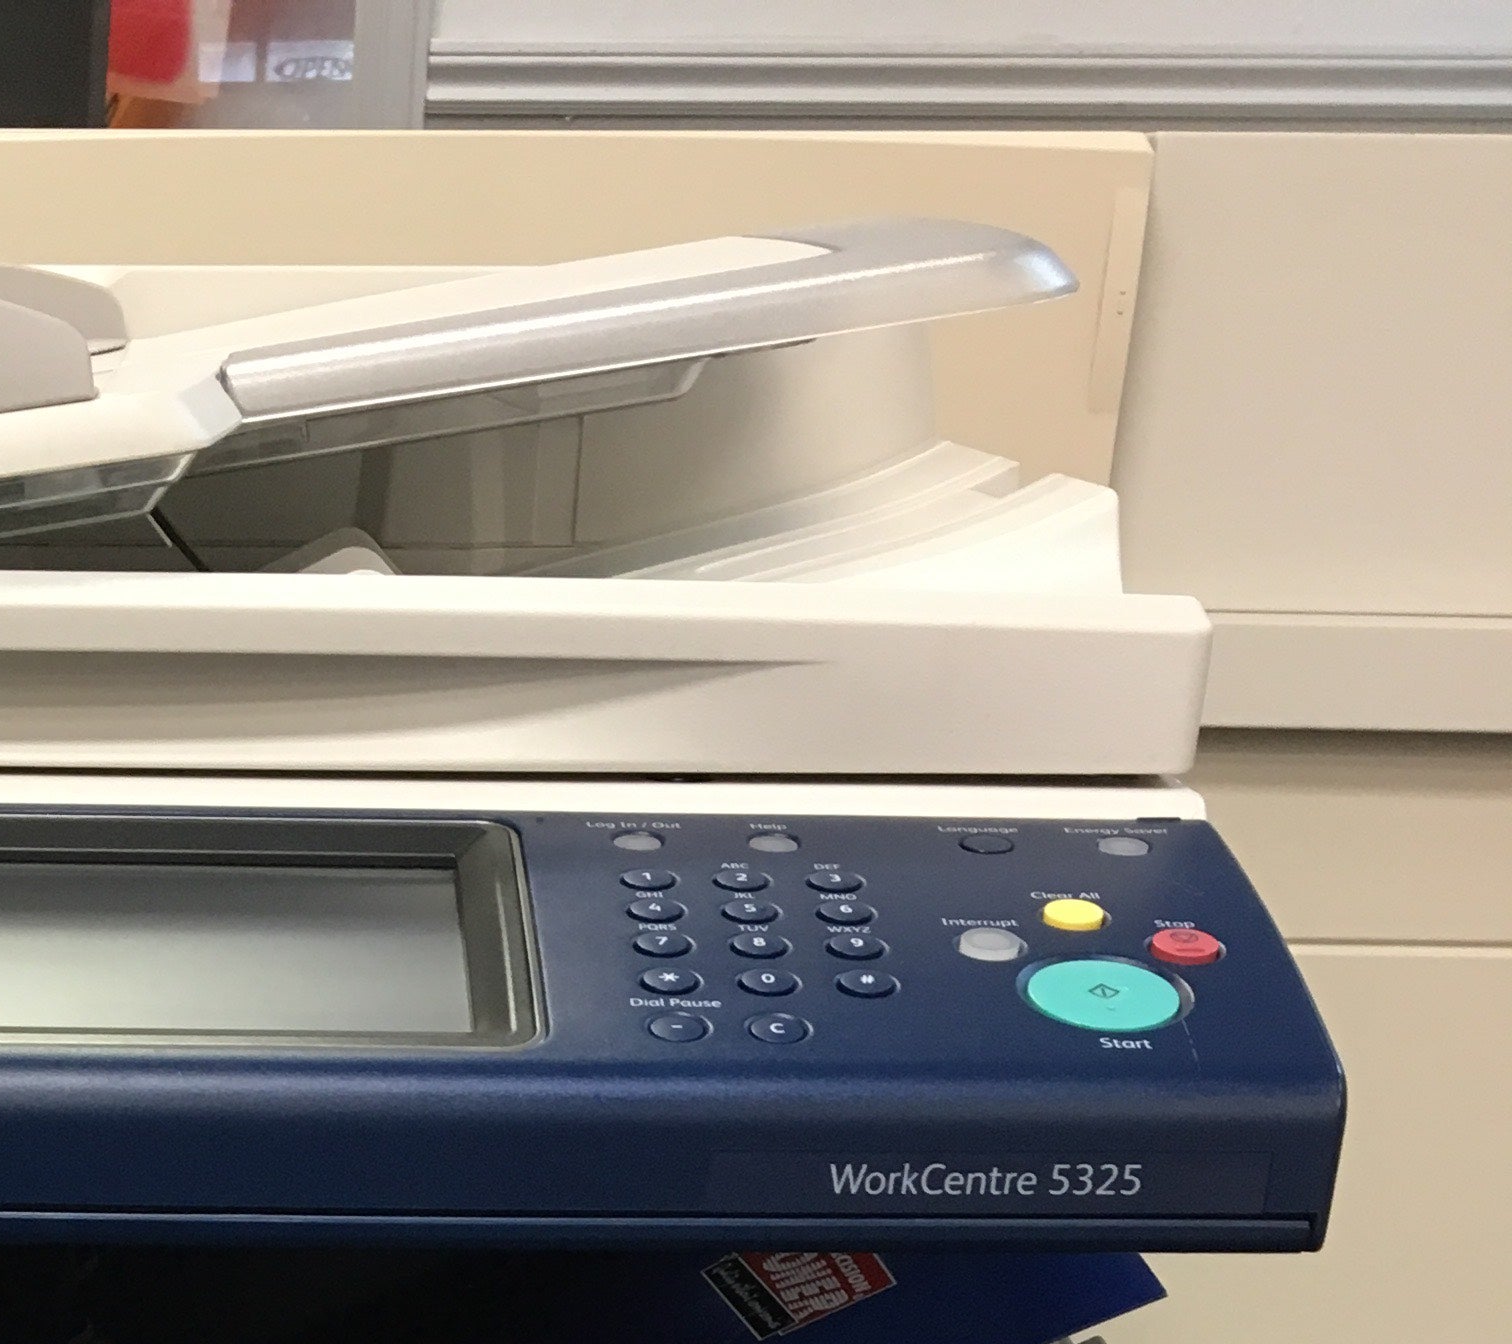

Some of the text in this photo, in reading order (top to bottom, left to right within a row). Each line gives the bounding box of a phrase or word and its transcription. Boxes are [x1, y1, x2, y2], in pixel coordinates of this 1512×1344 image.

[586, 821, 615, 829] Log
[621, 821, 637, 829] In
[652, 821, 682, 830] Out
[749, 823, 787, 831] Help
[937, 825, 1019, 834] Language
[1063, 826, 1119, 835] Energy
[642, 872, 652, 881] 1
[736, 873, 748, 882] 2
[829, 874, 841, 882] 3
[819, 893, 858, 901] MNO
[1030, 891, 1100, 900] Clear All
[649, 903, 662, 911] 4
[744, 904, 757, 912] 5
[839, 904, 853, 914] 6
[941, 917, 1019, 927] Interrupt
[1154, 919, 1196, 929] Stop
[639, 923, 677, 931] PQRS
[738, 924, 769, 932] TUV
[827, 925, 872, 934] WXYZ
[655, 936, 668, 946] 7
[753, 937, 766, 947] 8
[850, 938, 864, 947] 9
[629, 998, 722, 1008] Dial Pause
[769, 1022, 786, 1034] C
[1099, 1037, 1154, 1050] Start
[830, 1162, 1143, 1196] WorkCentre 5325
